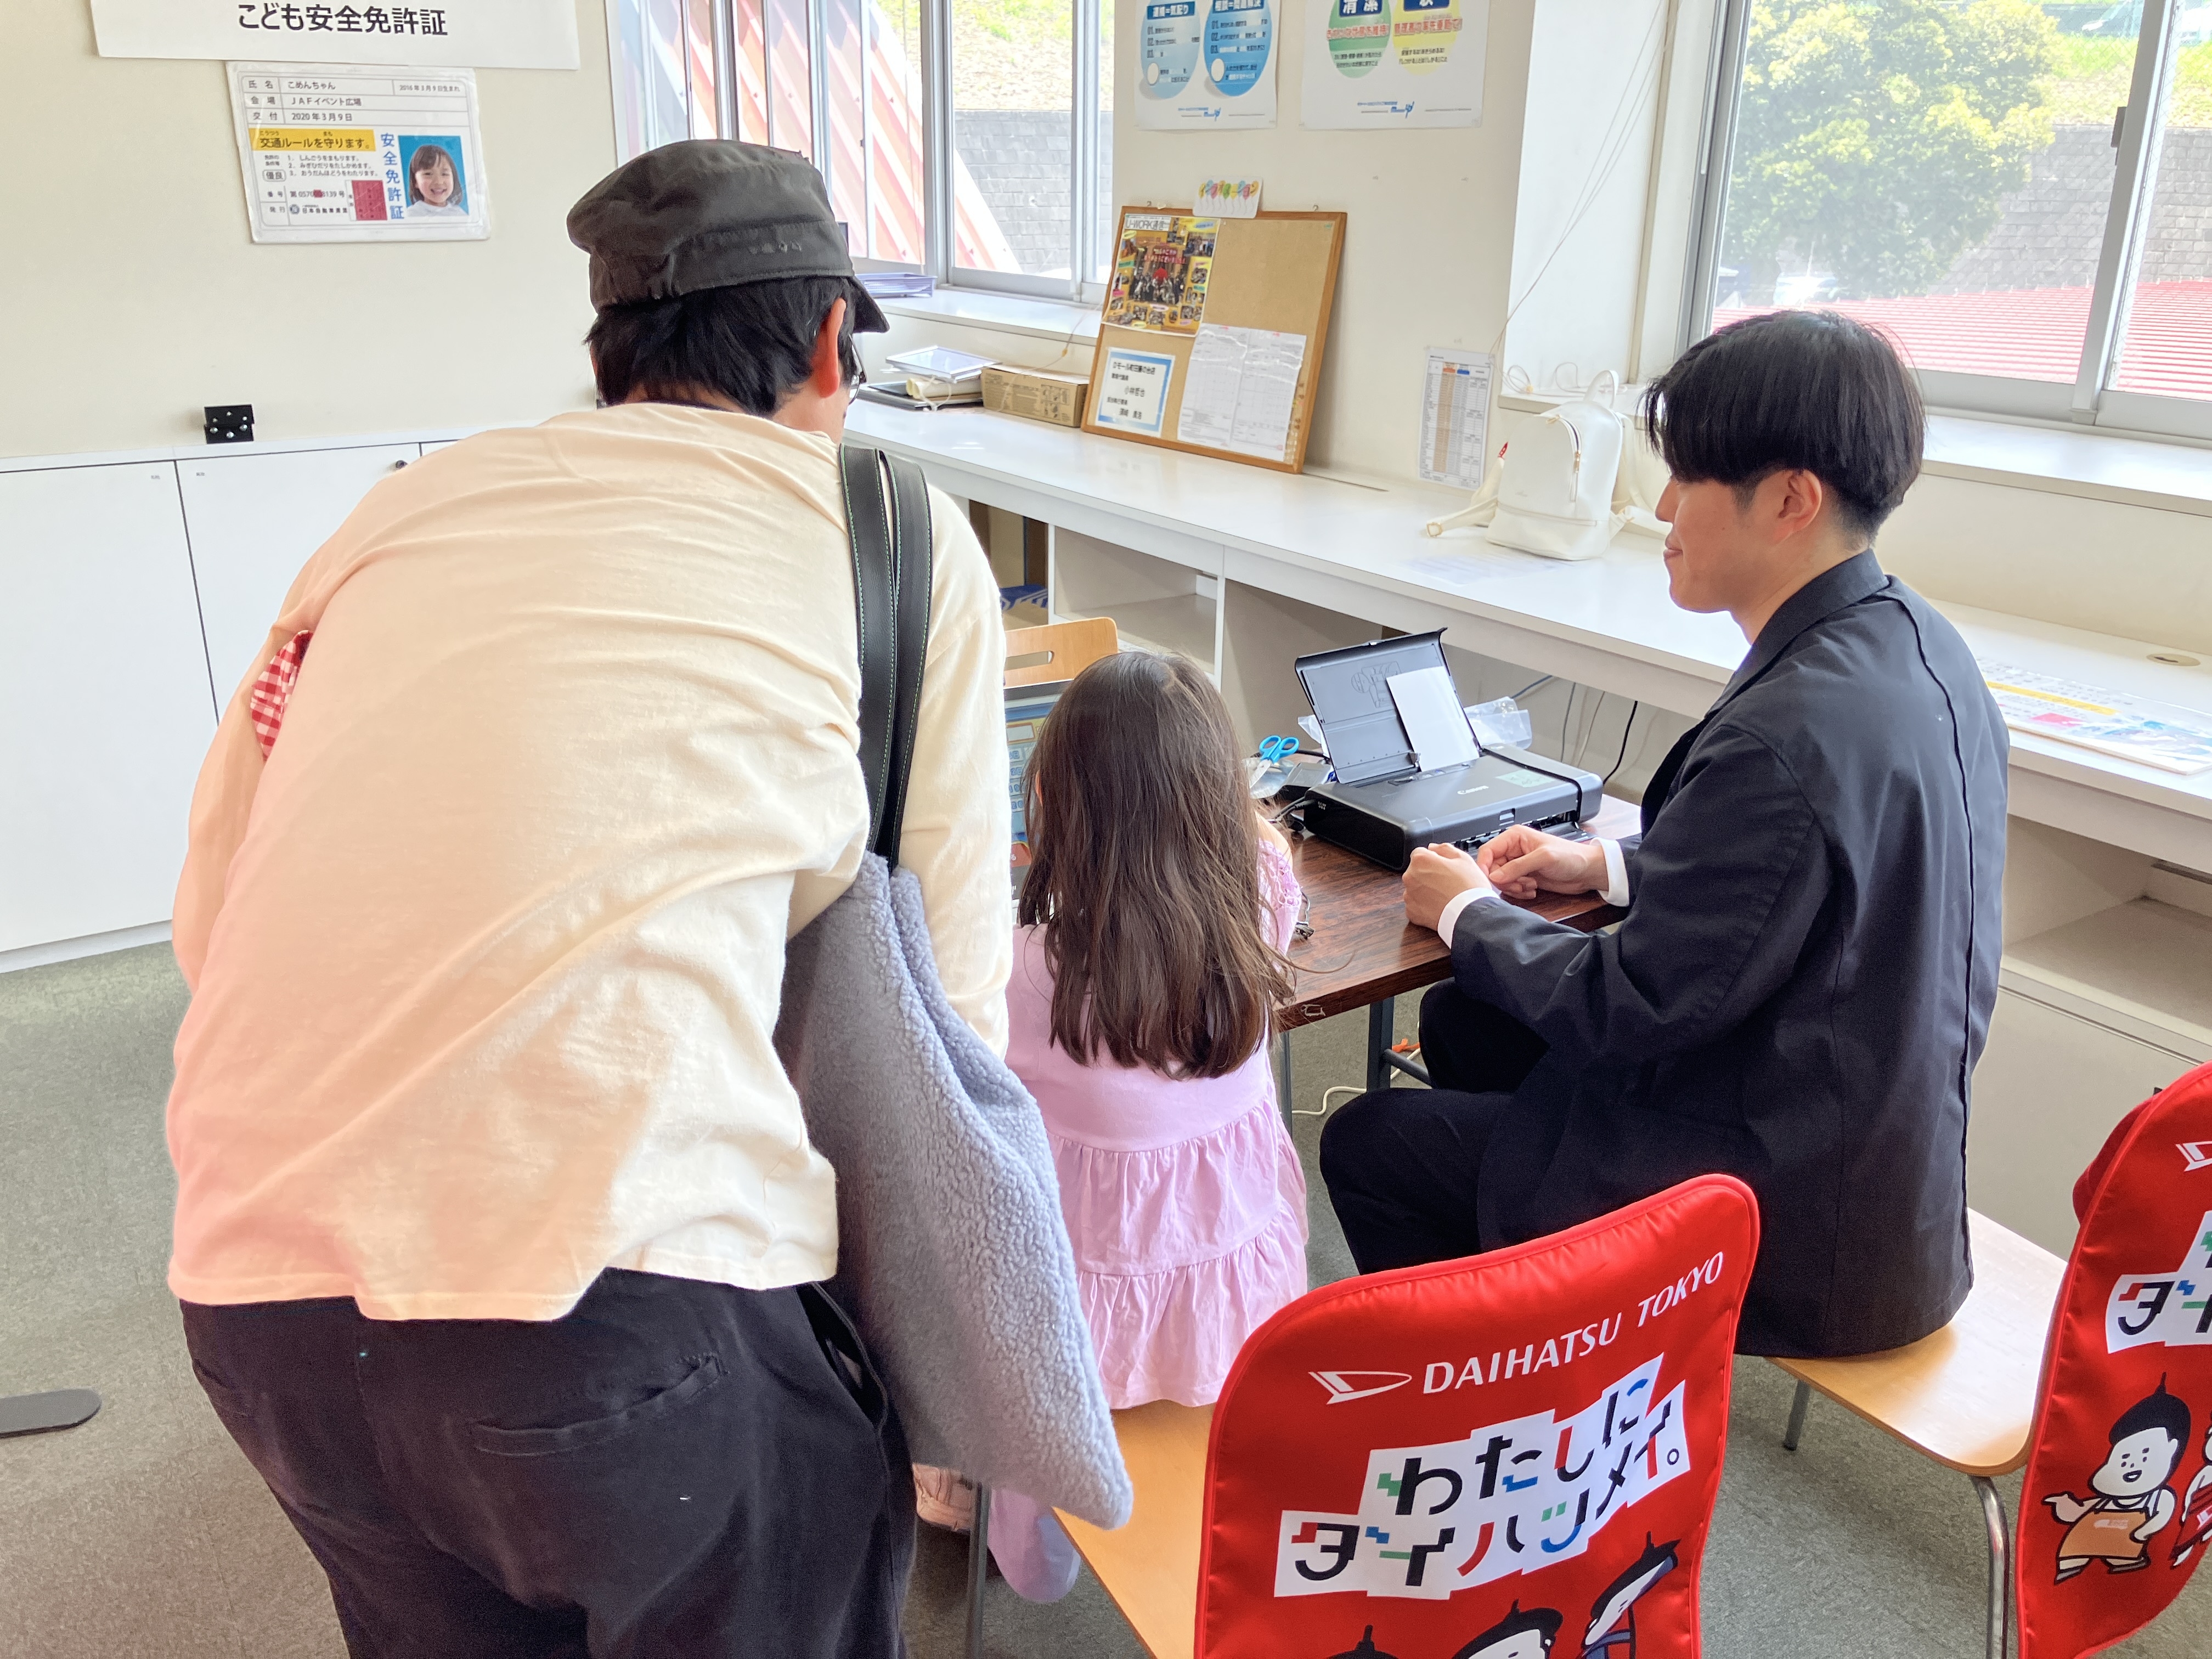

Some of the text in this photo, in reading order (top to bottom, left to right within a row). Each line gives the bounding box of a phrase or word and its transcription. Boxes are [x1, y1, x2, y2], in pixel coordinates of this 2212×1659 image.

[238, 3, 448, 36] こども安全免許証
[249, 80, 274, 89] 氏名
[287, 81, 336, 90] こめんちゃん
[251, 96, 276, 105] 会場
[253, 112, 278, 120] 交付
[291, 112, 353, 121] 2020年3月9日
[259, 137, 370, 149] 交通ルールを守ります。
[381, 132, 404, 219] 安全免許証
[1423, 1251, 1724, 1394] DAIHATSU TOKYO
[1377, 1378, 1649, 1515] わたしに
